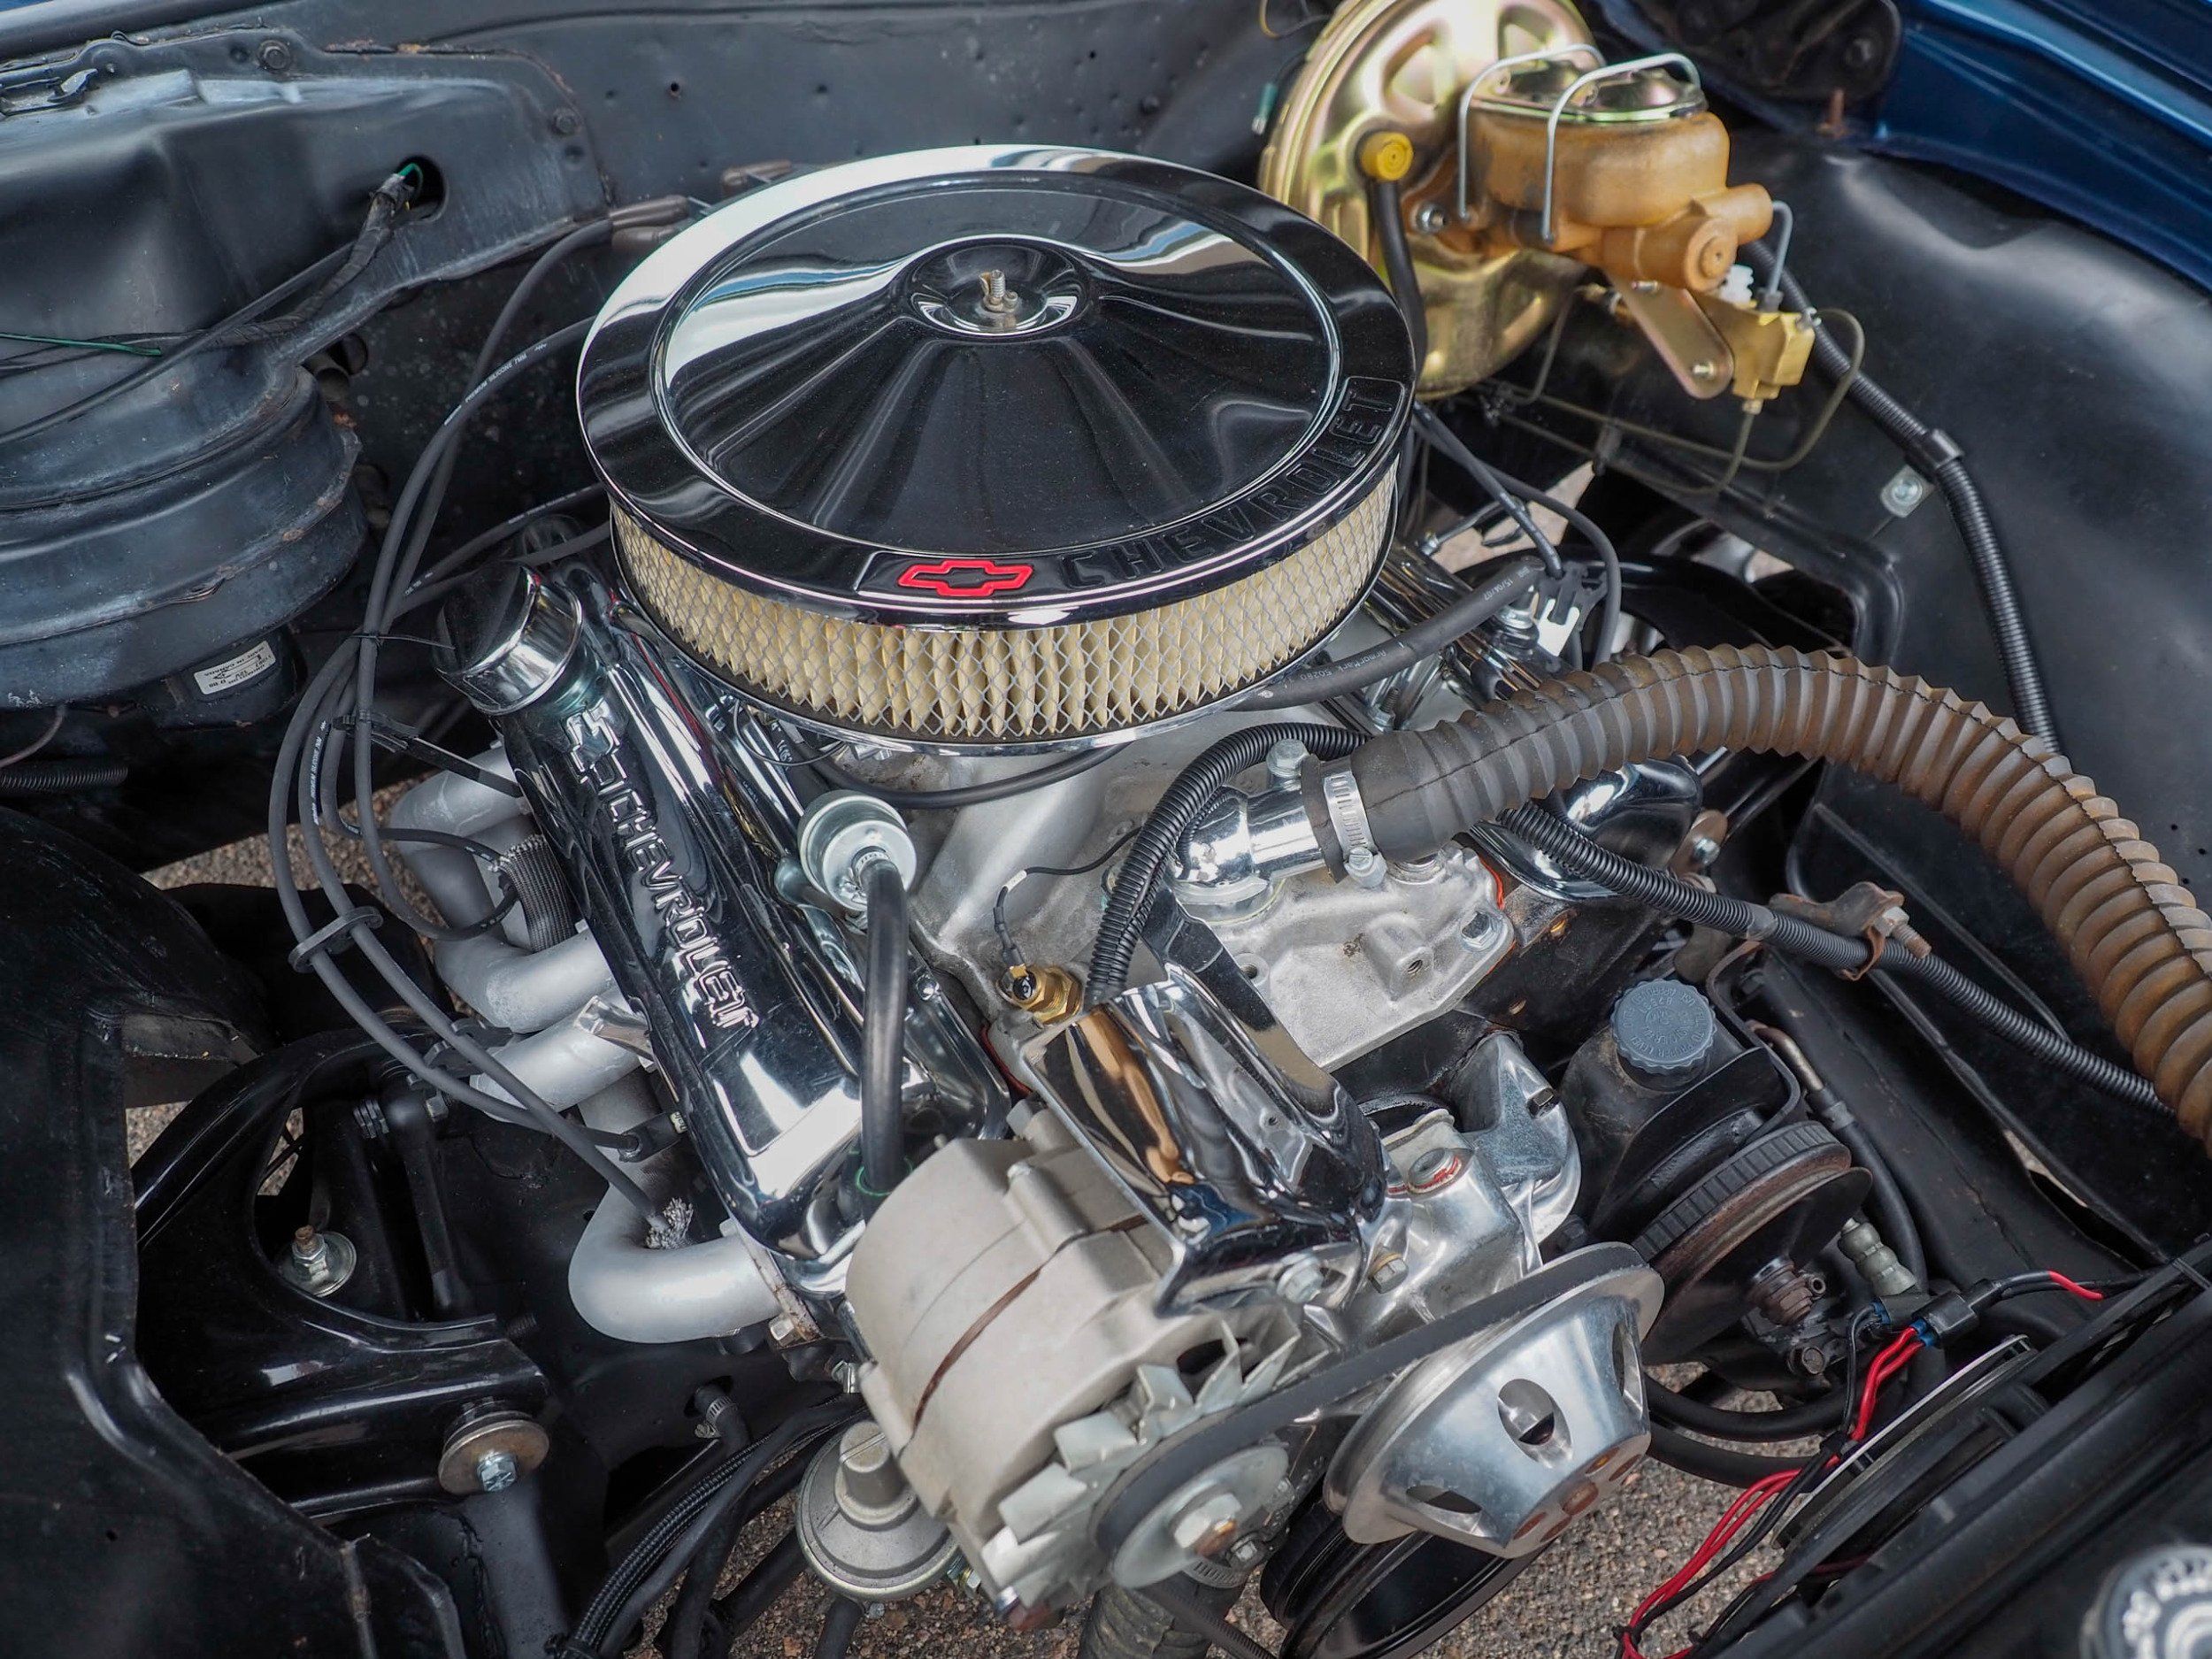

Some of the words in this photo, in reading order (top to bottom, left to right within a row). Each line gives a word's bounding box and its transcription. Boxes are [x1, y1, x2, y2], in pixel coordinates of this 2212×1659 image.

[465, 380, 488, 403] PREMIUM
[488, 362, 513, 382] SILICONE
[1061, 392, 1394, 589] CHEVROLET
[609, 788, 760, 1030] CHEVROLET
